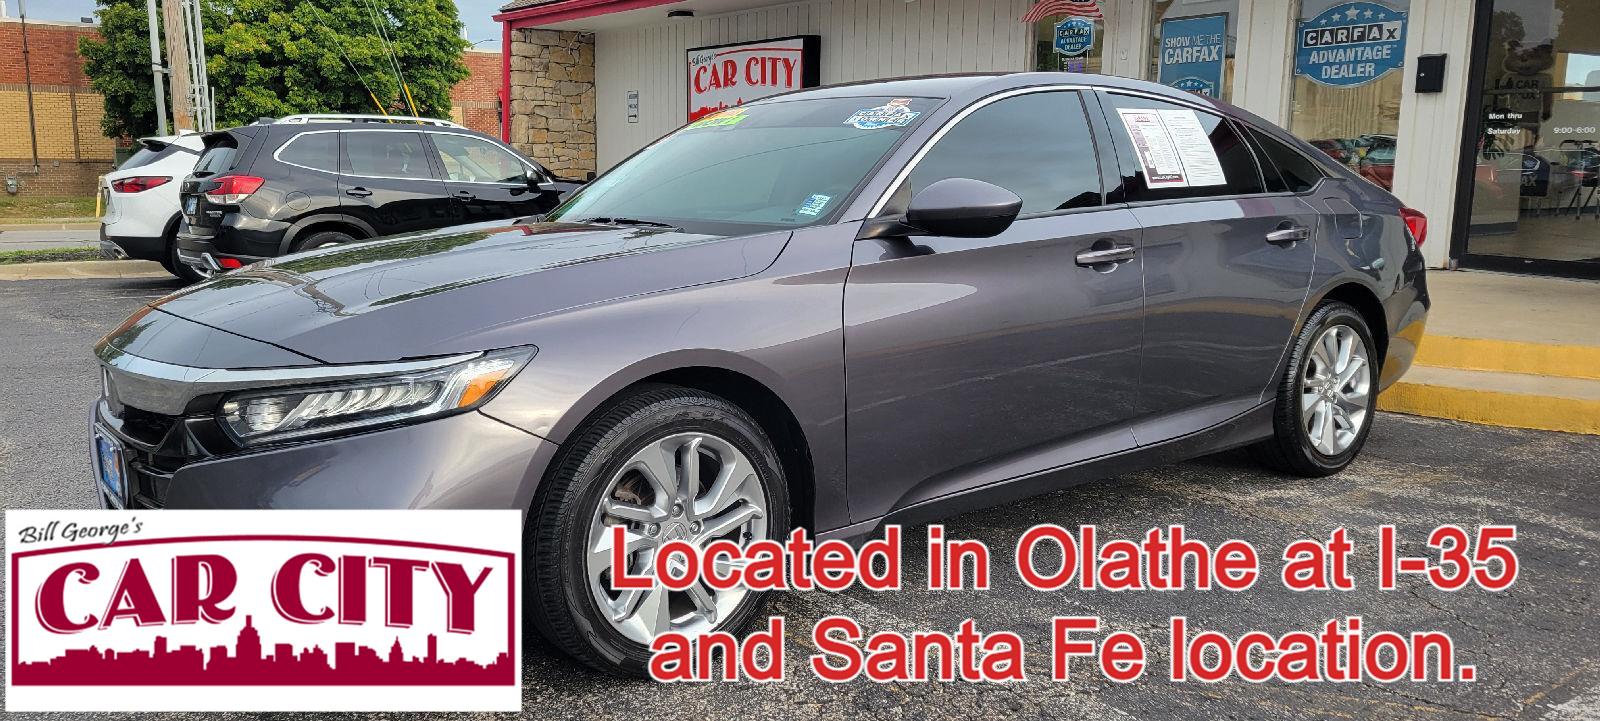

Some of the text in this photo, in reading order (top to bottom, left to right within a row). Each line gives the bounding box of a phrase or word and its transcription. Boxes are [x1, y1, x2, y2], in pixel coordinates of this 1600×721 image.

[1059, 27, 1089, 37] CARFAX
[1165, 33, 1221, 48] SHOW ME THE
[1304, 26, 1399, 45] CARFAX
[1164, 45, 1222, 65] CARFAX
[1308, 45, 1392, 64] ADVANTAGE
[694, 56, 797, 94] CAR CITY
[1321, 62, 1376, 79] DEALER
[1507, 113, 1523, 121] thru
[1487, 126, 1596, 136] Saturday 9:00-6:00
